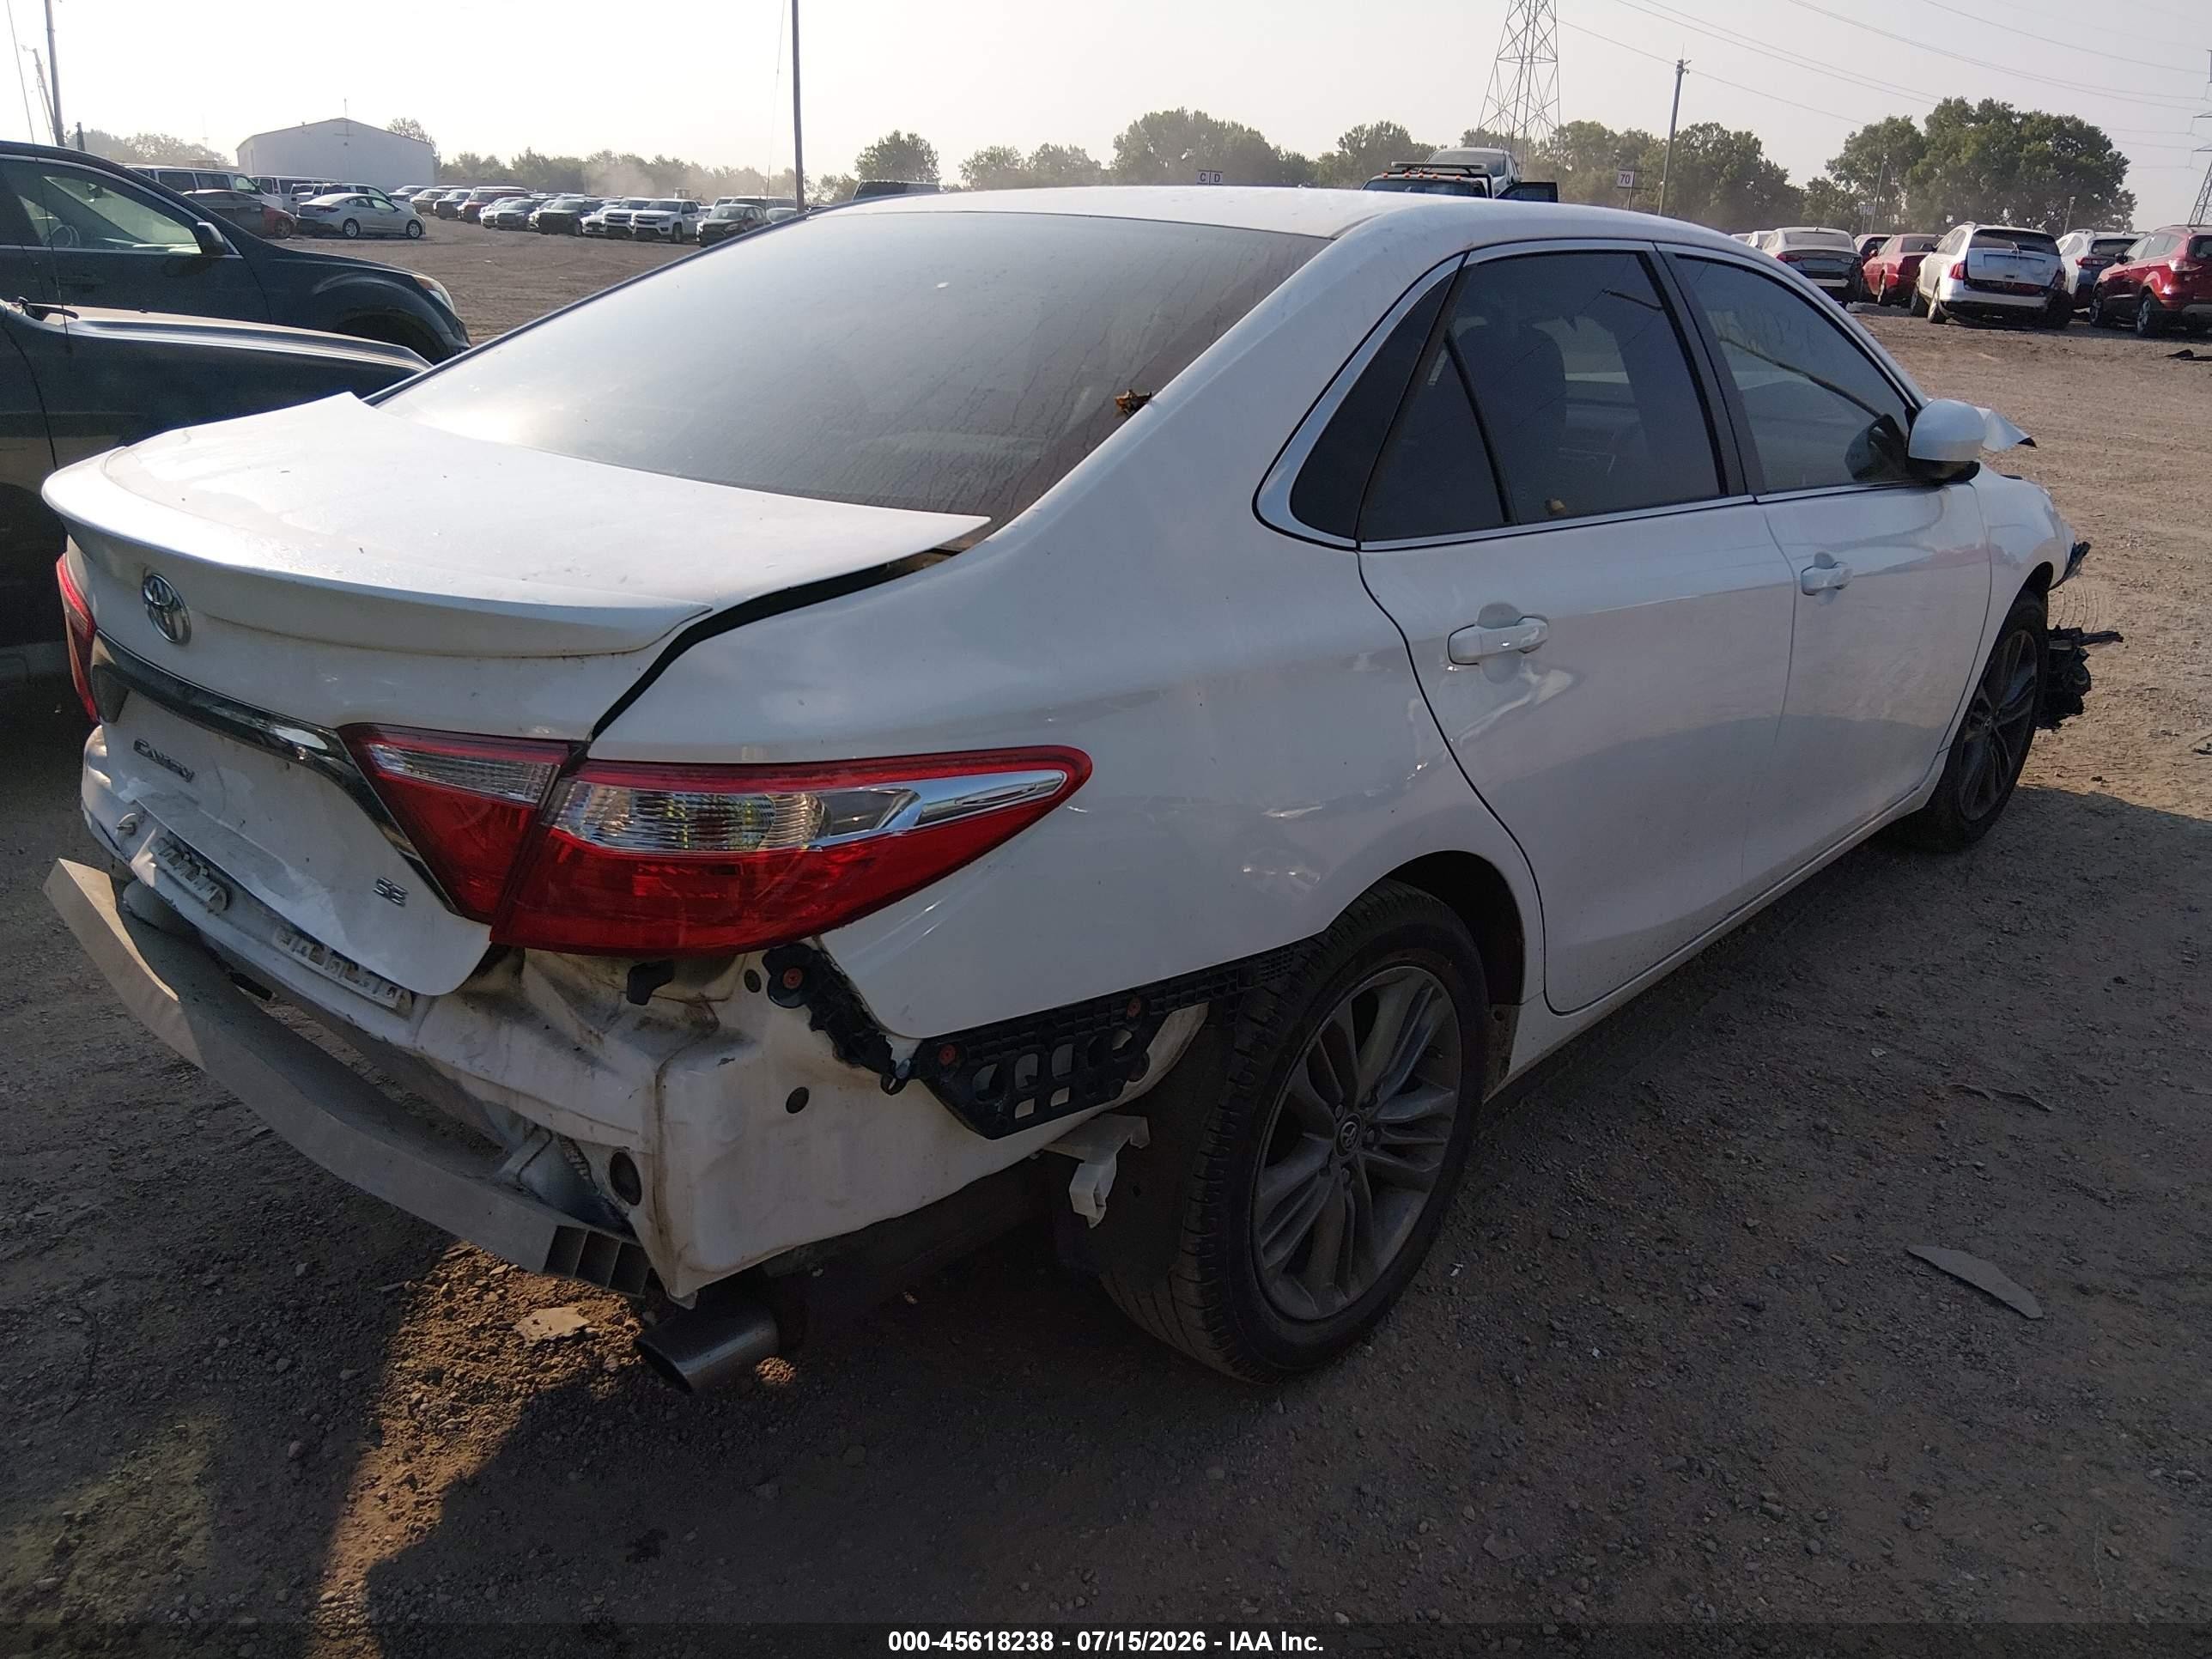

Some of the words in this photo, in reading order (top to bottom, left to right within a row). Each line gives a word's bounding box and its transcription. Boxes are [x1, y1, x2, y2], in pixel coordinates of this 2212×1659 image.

[1200, 173, 1206, 182] C
[1214, 173, 1221, 183] D
[1620, 173, 1631, 185] 70
[373, 877, 409, 908] SE
